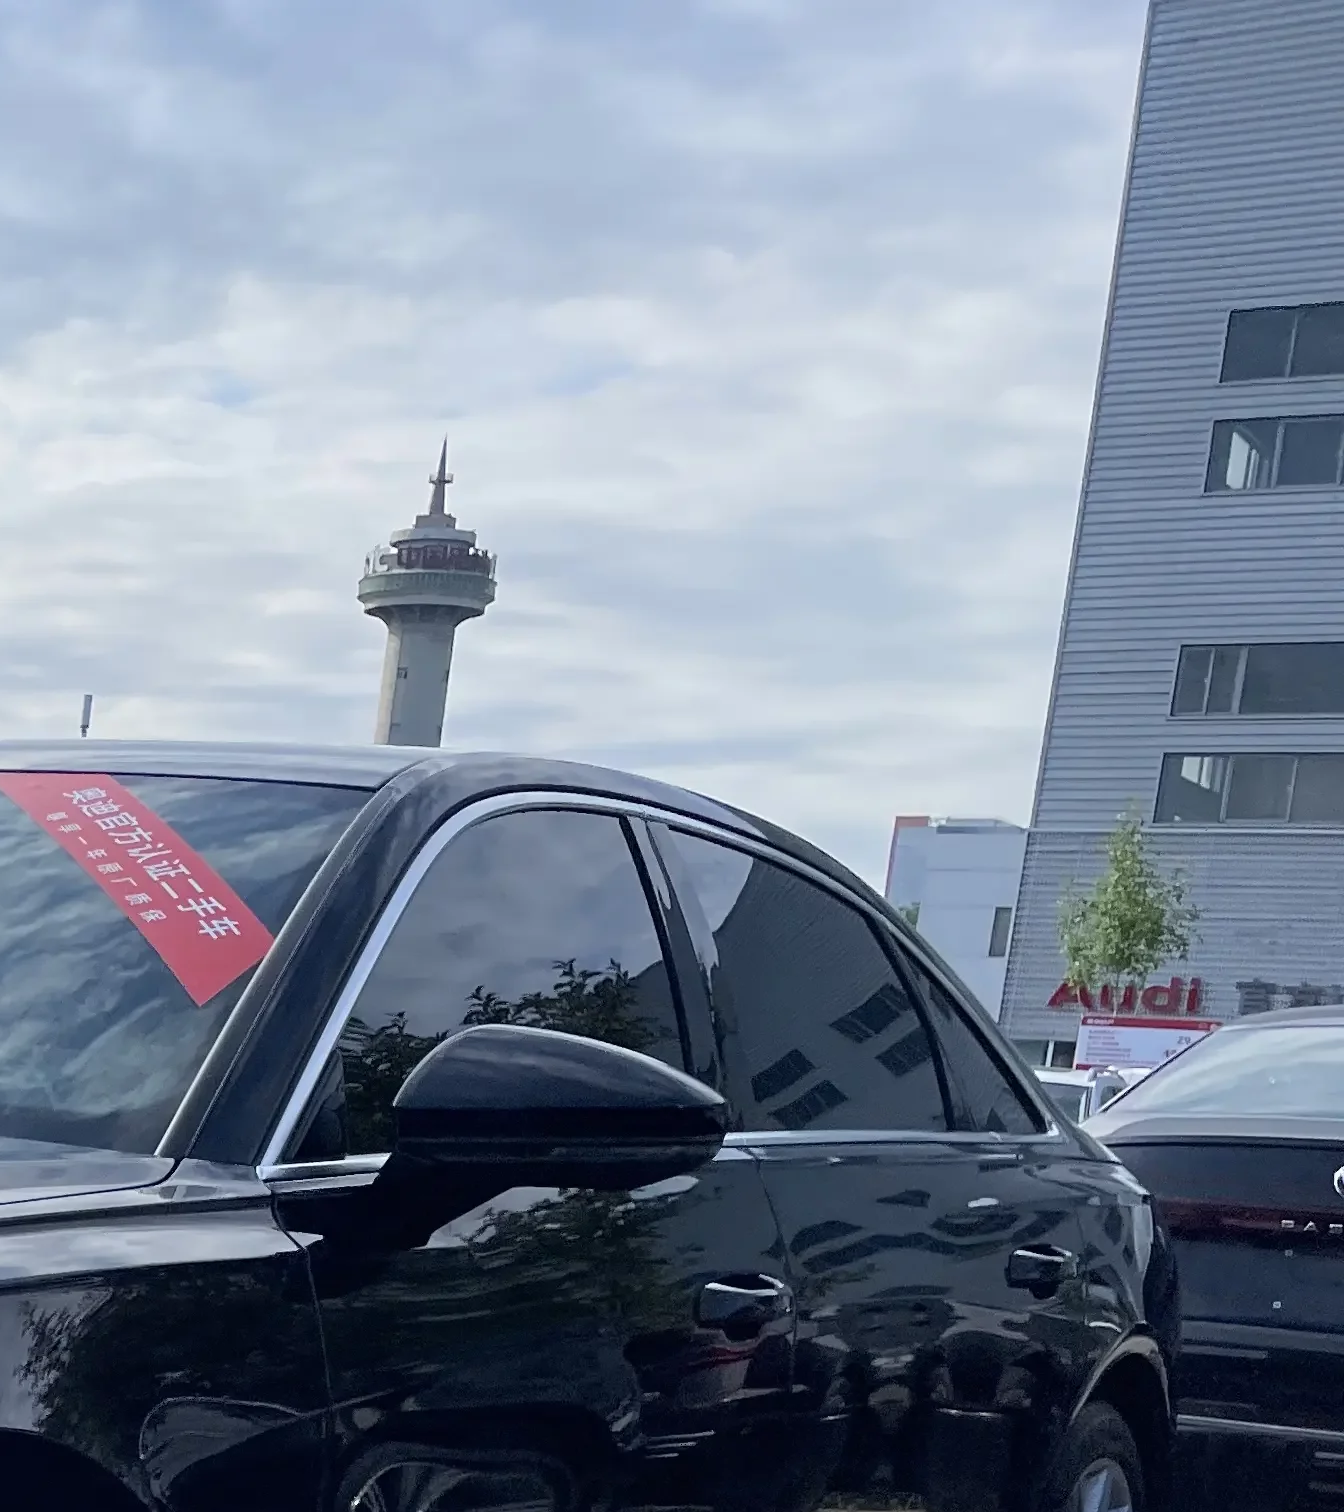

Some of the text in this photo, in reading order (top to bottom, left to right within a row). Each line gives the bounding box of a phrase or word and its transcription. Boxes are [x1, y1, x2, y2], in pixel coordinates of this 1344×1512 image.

[63, 787, 241, 939] 奥迪官方认证二手车
[1047, 977, 1202, 1013] Audi
